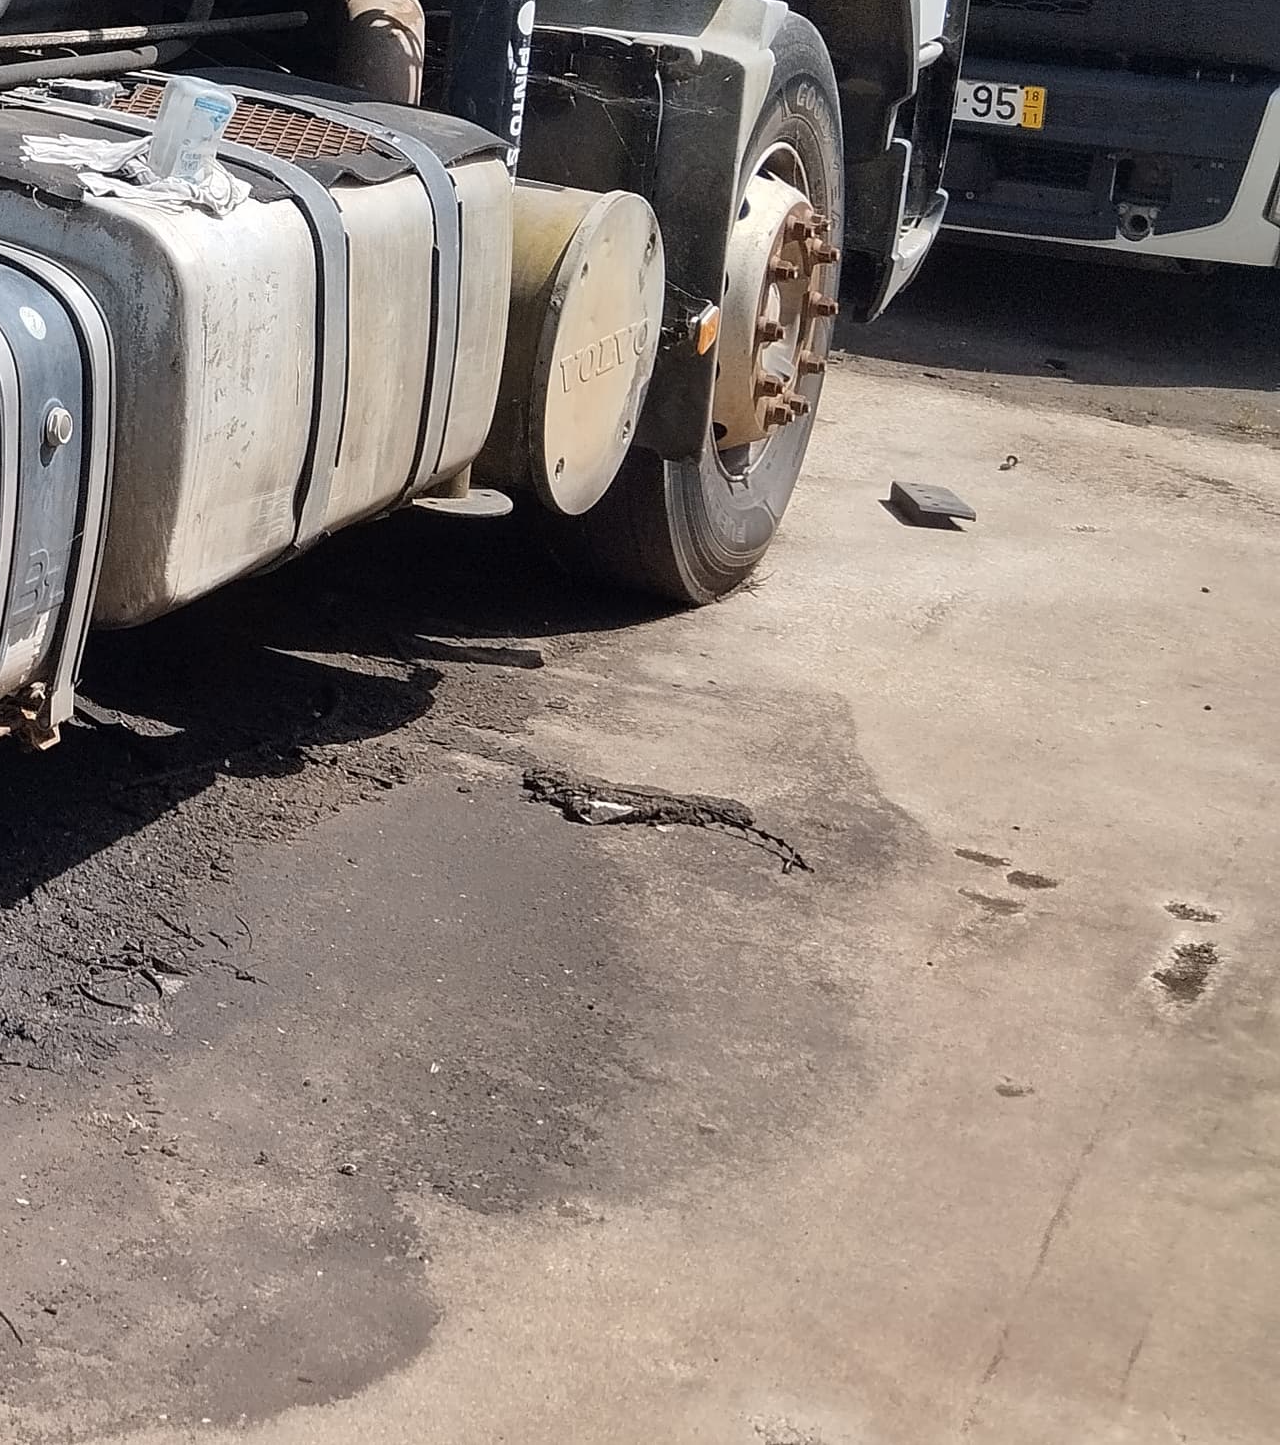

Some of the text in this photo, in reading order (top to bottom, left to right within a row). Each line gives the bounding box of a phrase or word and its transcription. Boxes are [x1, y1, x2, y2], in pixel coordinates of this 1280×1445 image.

[1024, 90, 1040, 102] 18
[1022, 112, 1038, 124] 11
[559, 317, 650, 394] VOLVO
